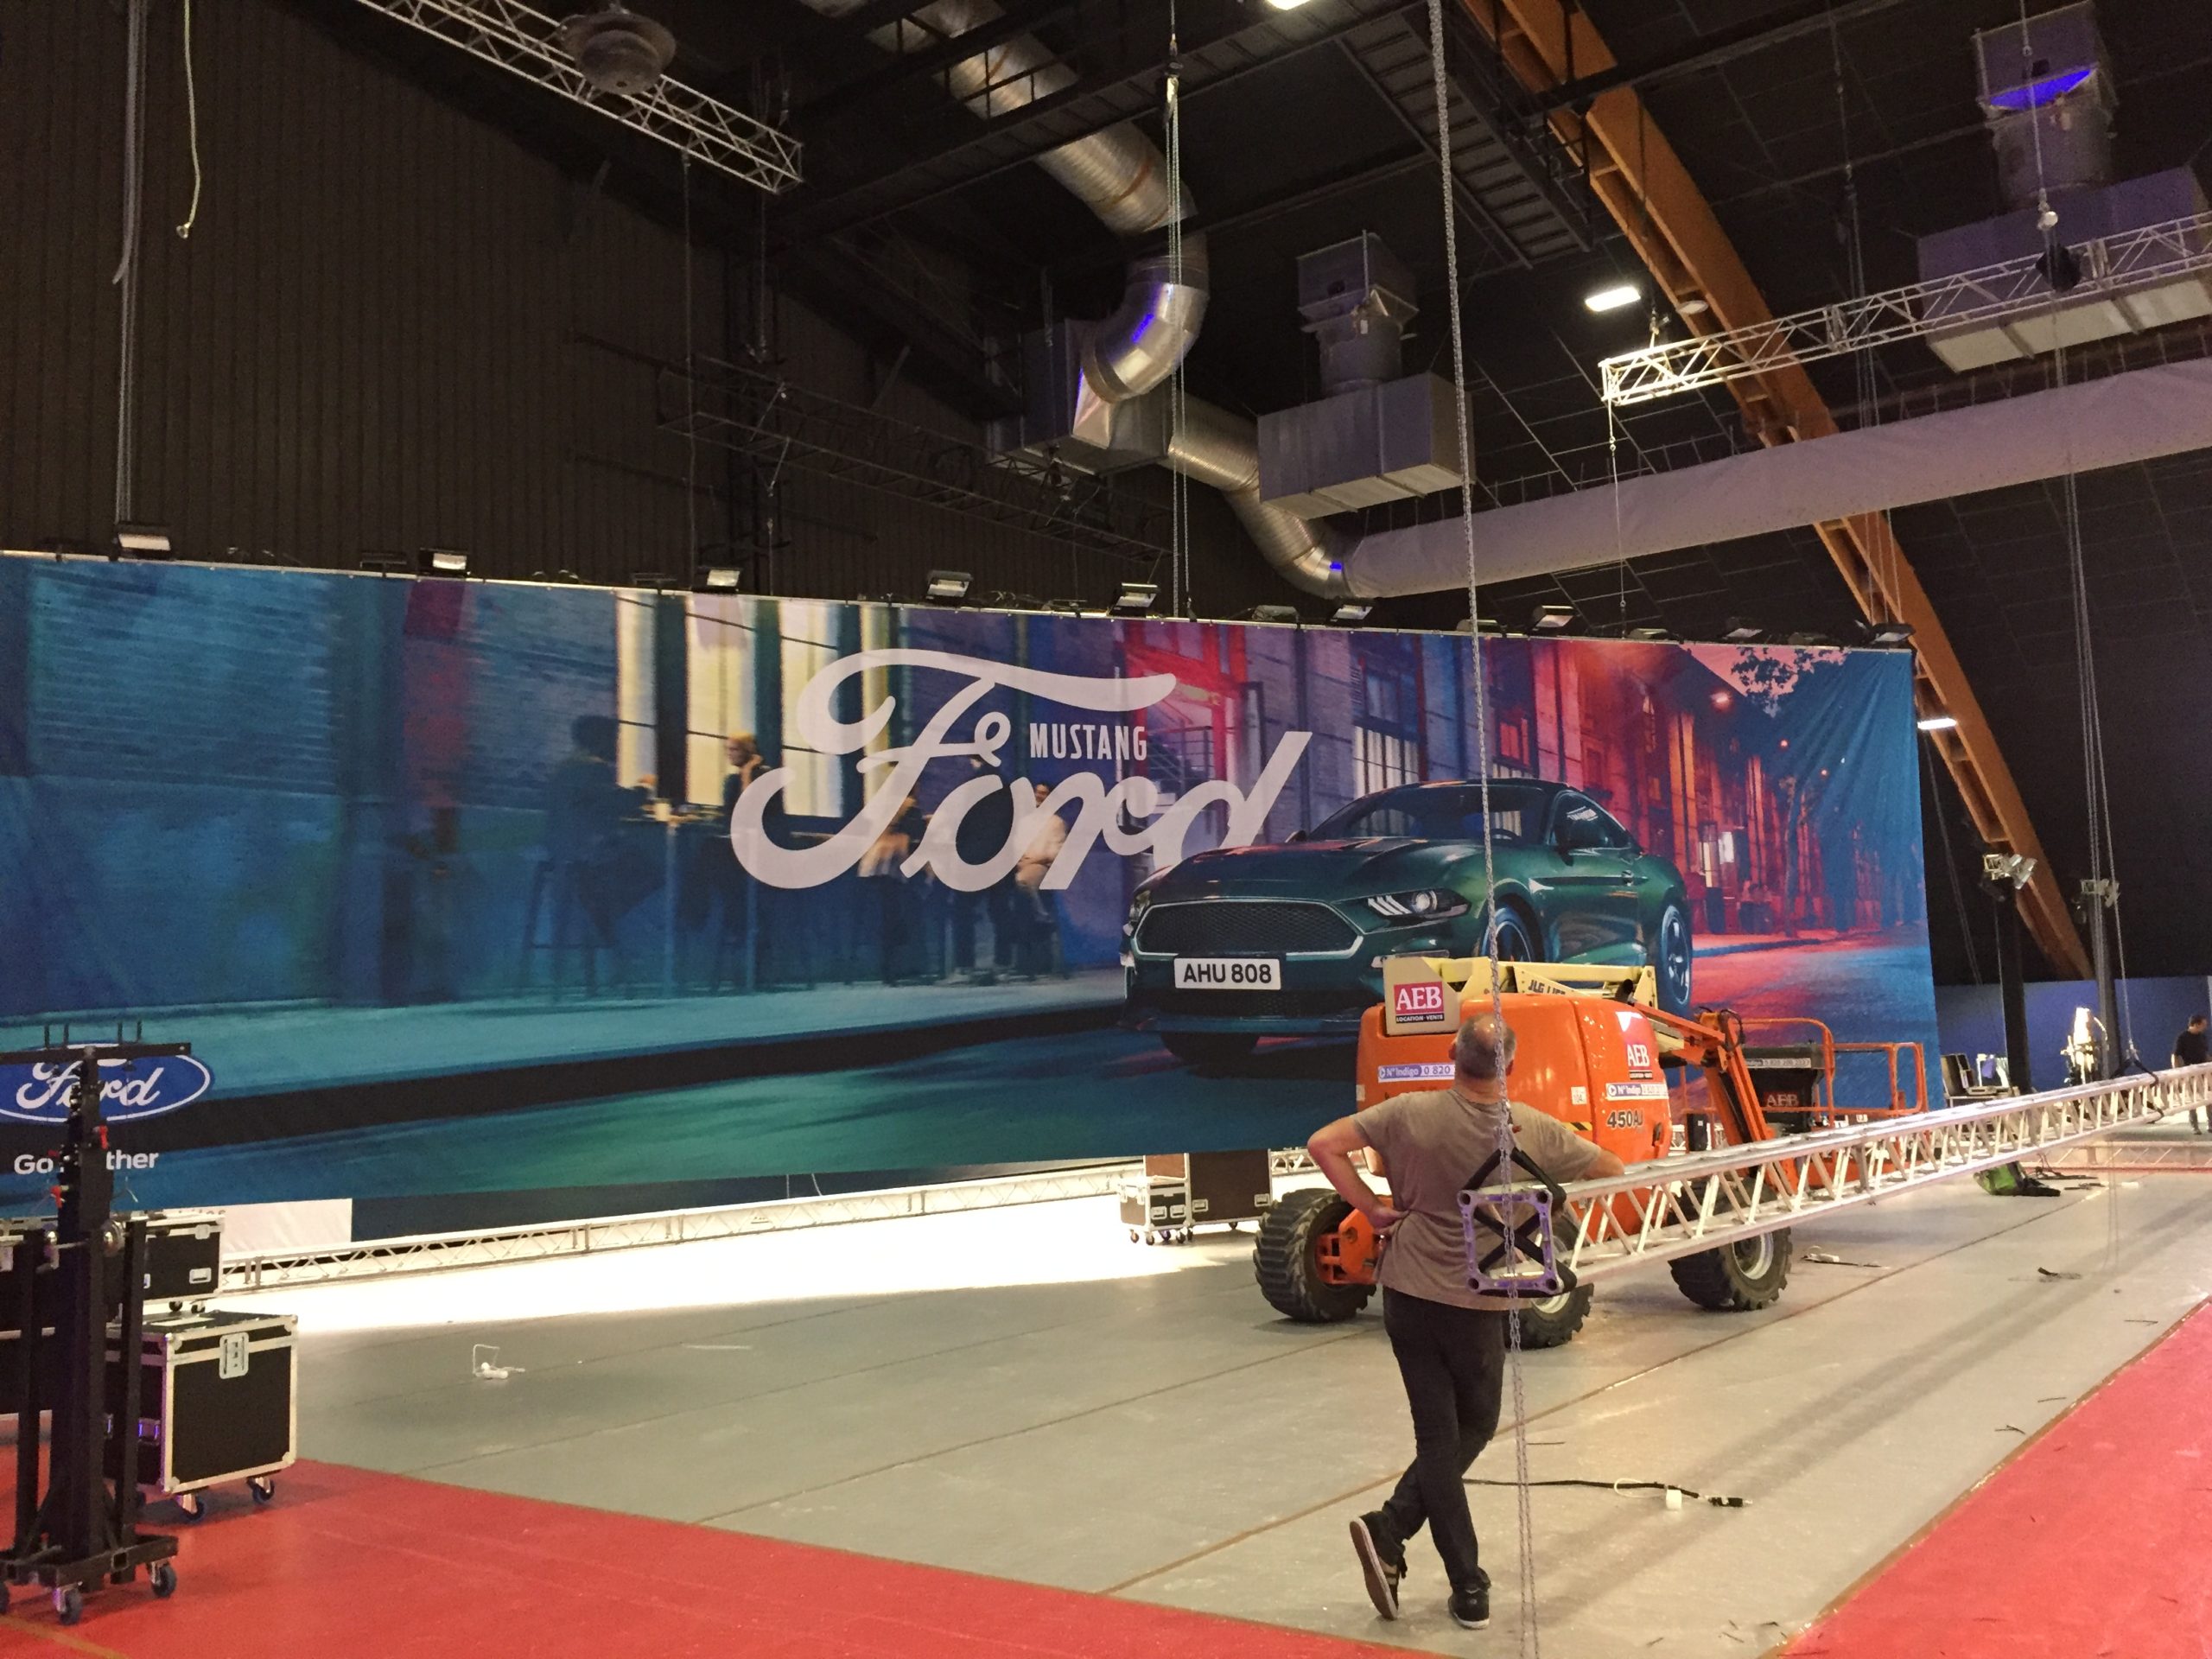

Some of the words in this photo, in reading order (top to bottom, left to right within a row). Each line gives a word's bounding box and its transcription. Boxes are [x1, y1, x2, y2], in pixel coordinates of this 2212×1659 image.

[1029, 722, 1147, 761] MUSTANG
[730, 648, 1313, 892] Ford
[1183, 963, 1226, 983] AHU
[1231, 963, 1272, 984] 808
[1528, 979, 1545, 994] JLG
[1395, 986, 1442, 1011] AEB
[1626, 1044, 1650, 1067] AEB
[1424, 1066, 1430, 1075] 0
[1433, 1065, 1451, 1075] 820
[1766, 1093, 1799, 1107] AEB
[14, 1154, 54, 1175] Go
